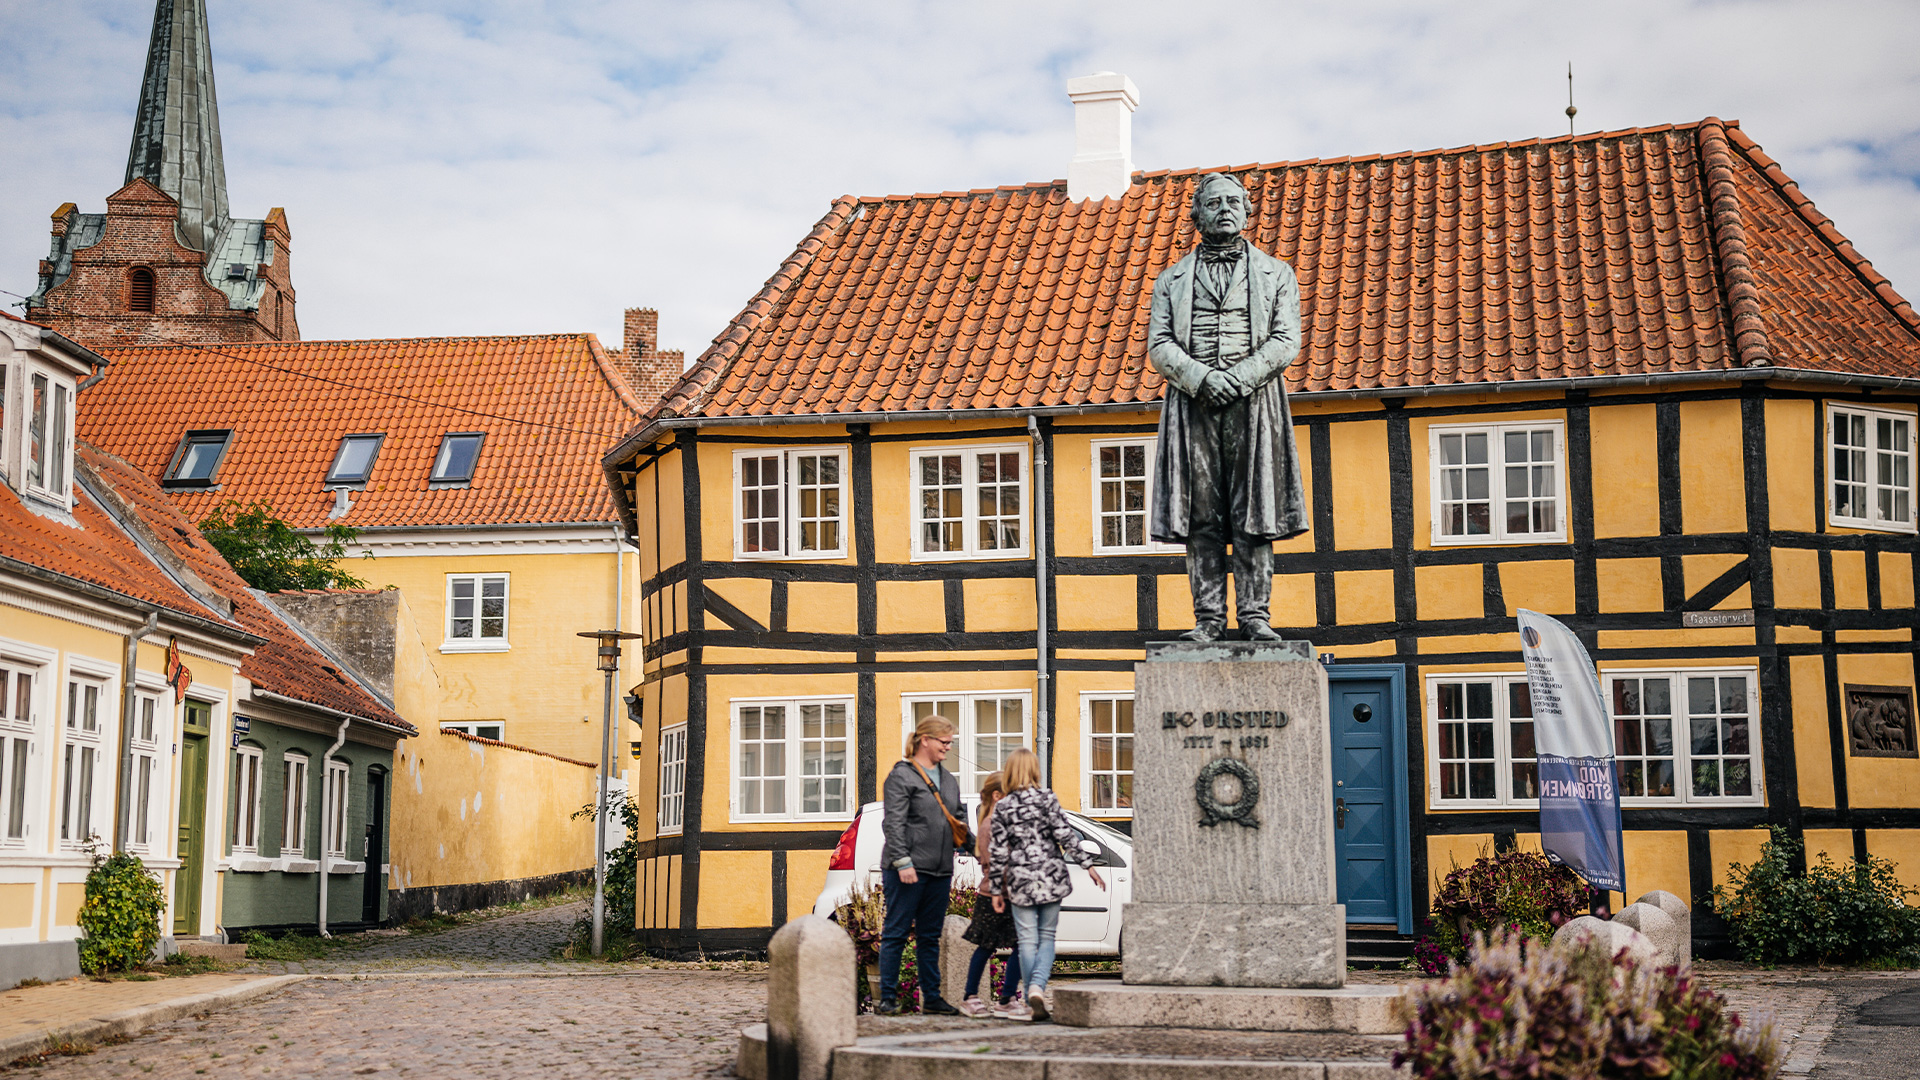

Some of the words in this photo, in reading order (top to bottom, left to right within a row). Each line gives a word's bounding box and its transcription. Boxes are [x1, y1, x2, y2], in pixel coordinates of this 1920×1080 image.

[1690, 613, 1747, 625] Gaasetorvet
[1203, 710, 1289, 728] ØRSTED
[1183, 735, 1214, 748] 1777
